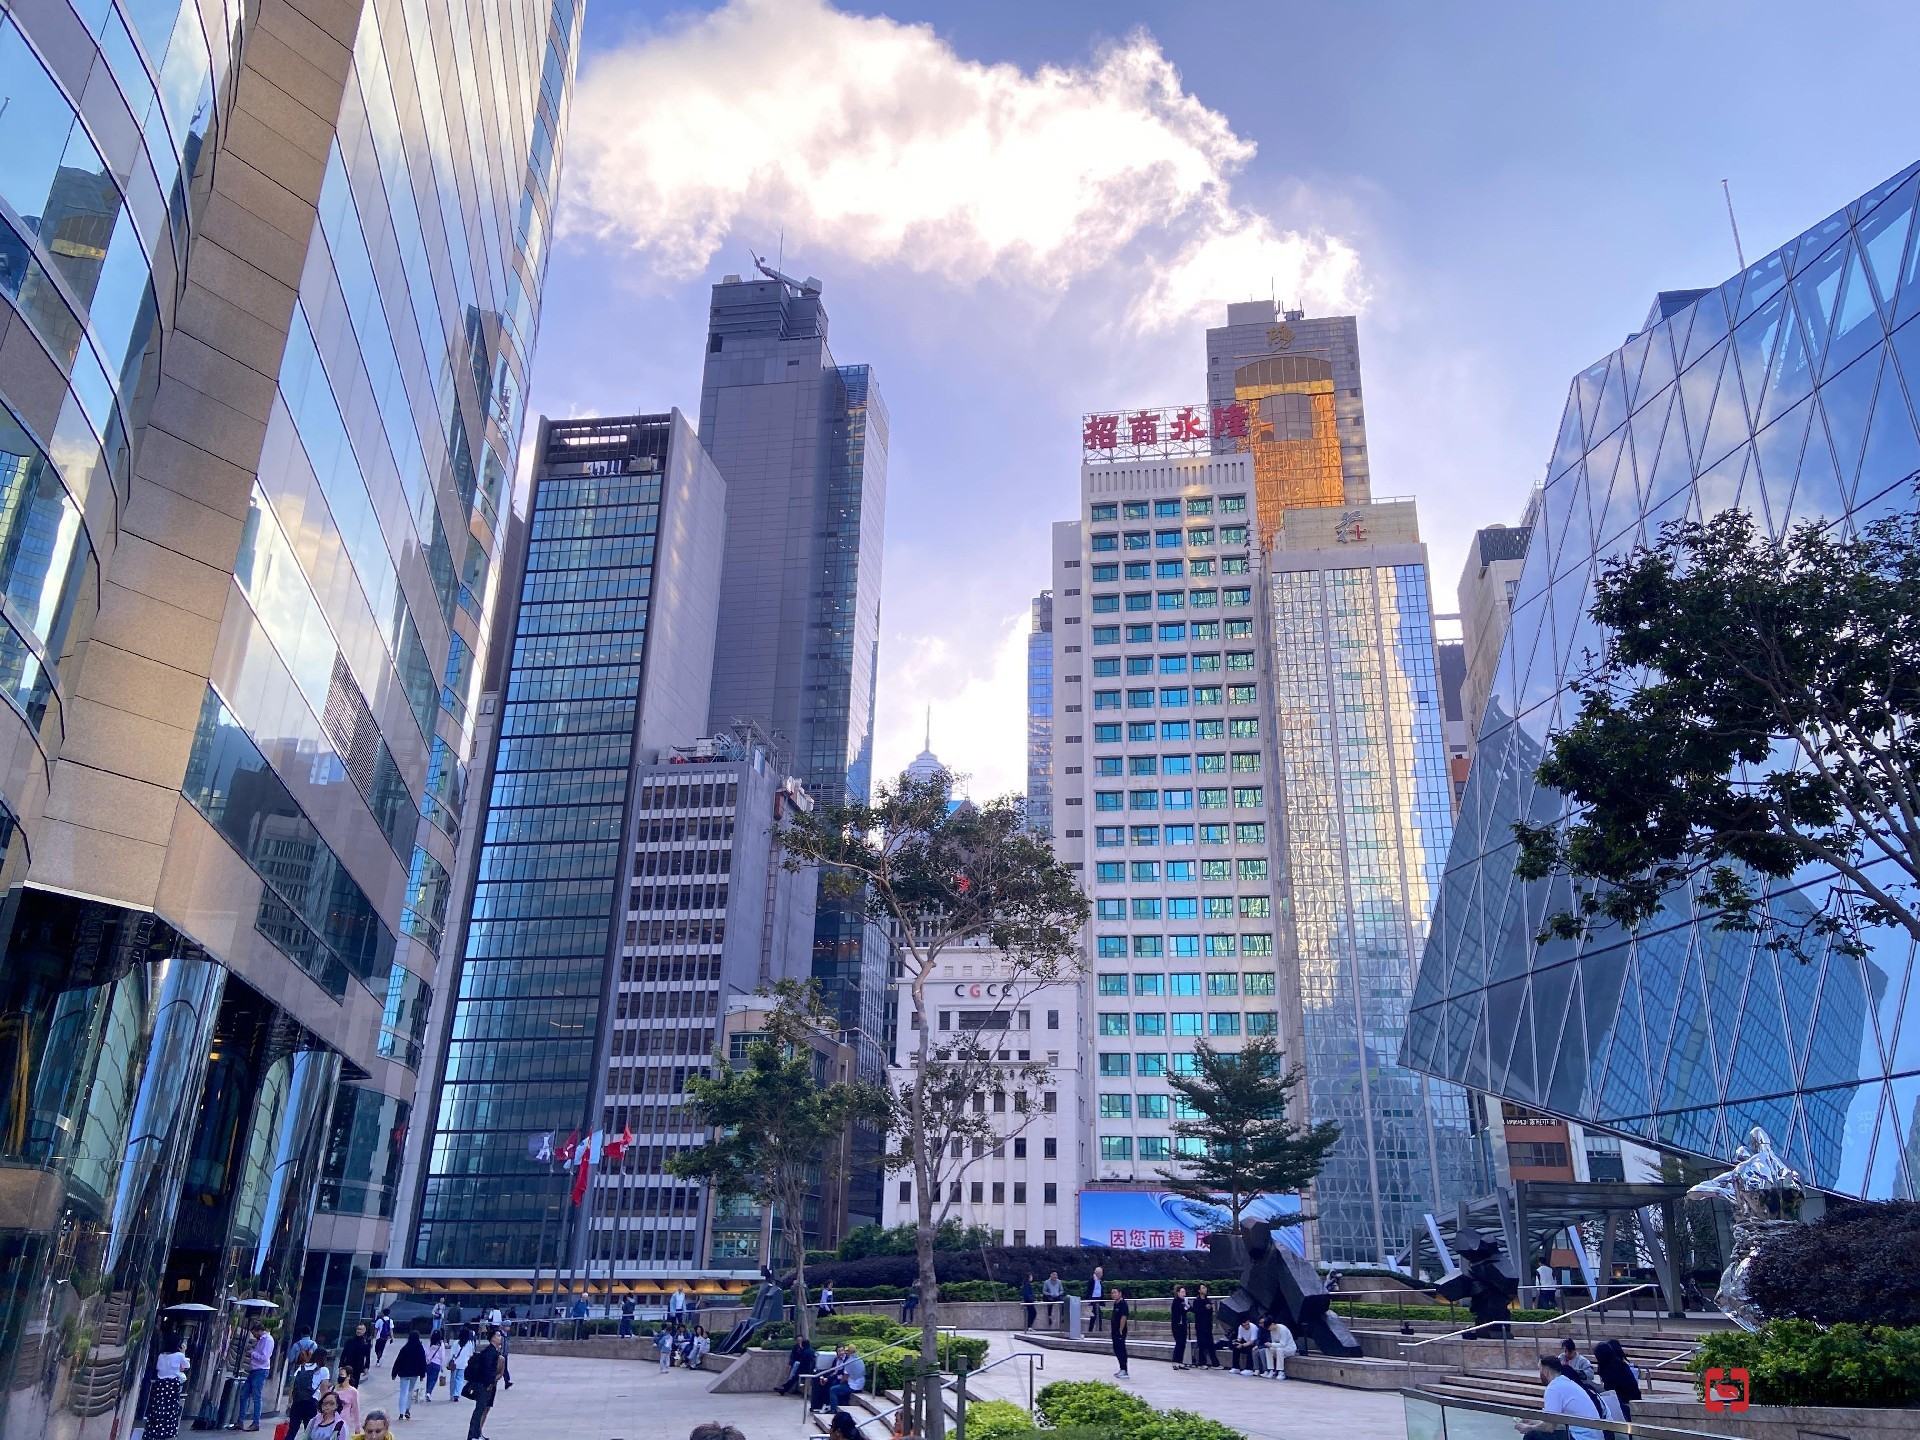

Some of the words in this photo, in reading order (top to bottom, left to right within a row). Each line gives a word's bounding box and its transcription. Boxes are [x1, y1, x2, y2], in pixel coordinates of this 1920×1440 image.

[1084, 404, 1250, 449] 招商永隆
[954, 983, 1013, 997] CGCC
[1110, 1229, 1185, 1249] 因您而變
